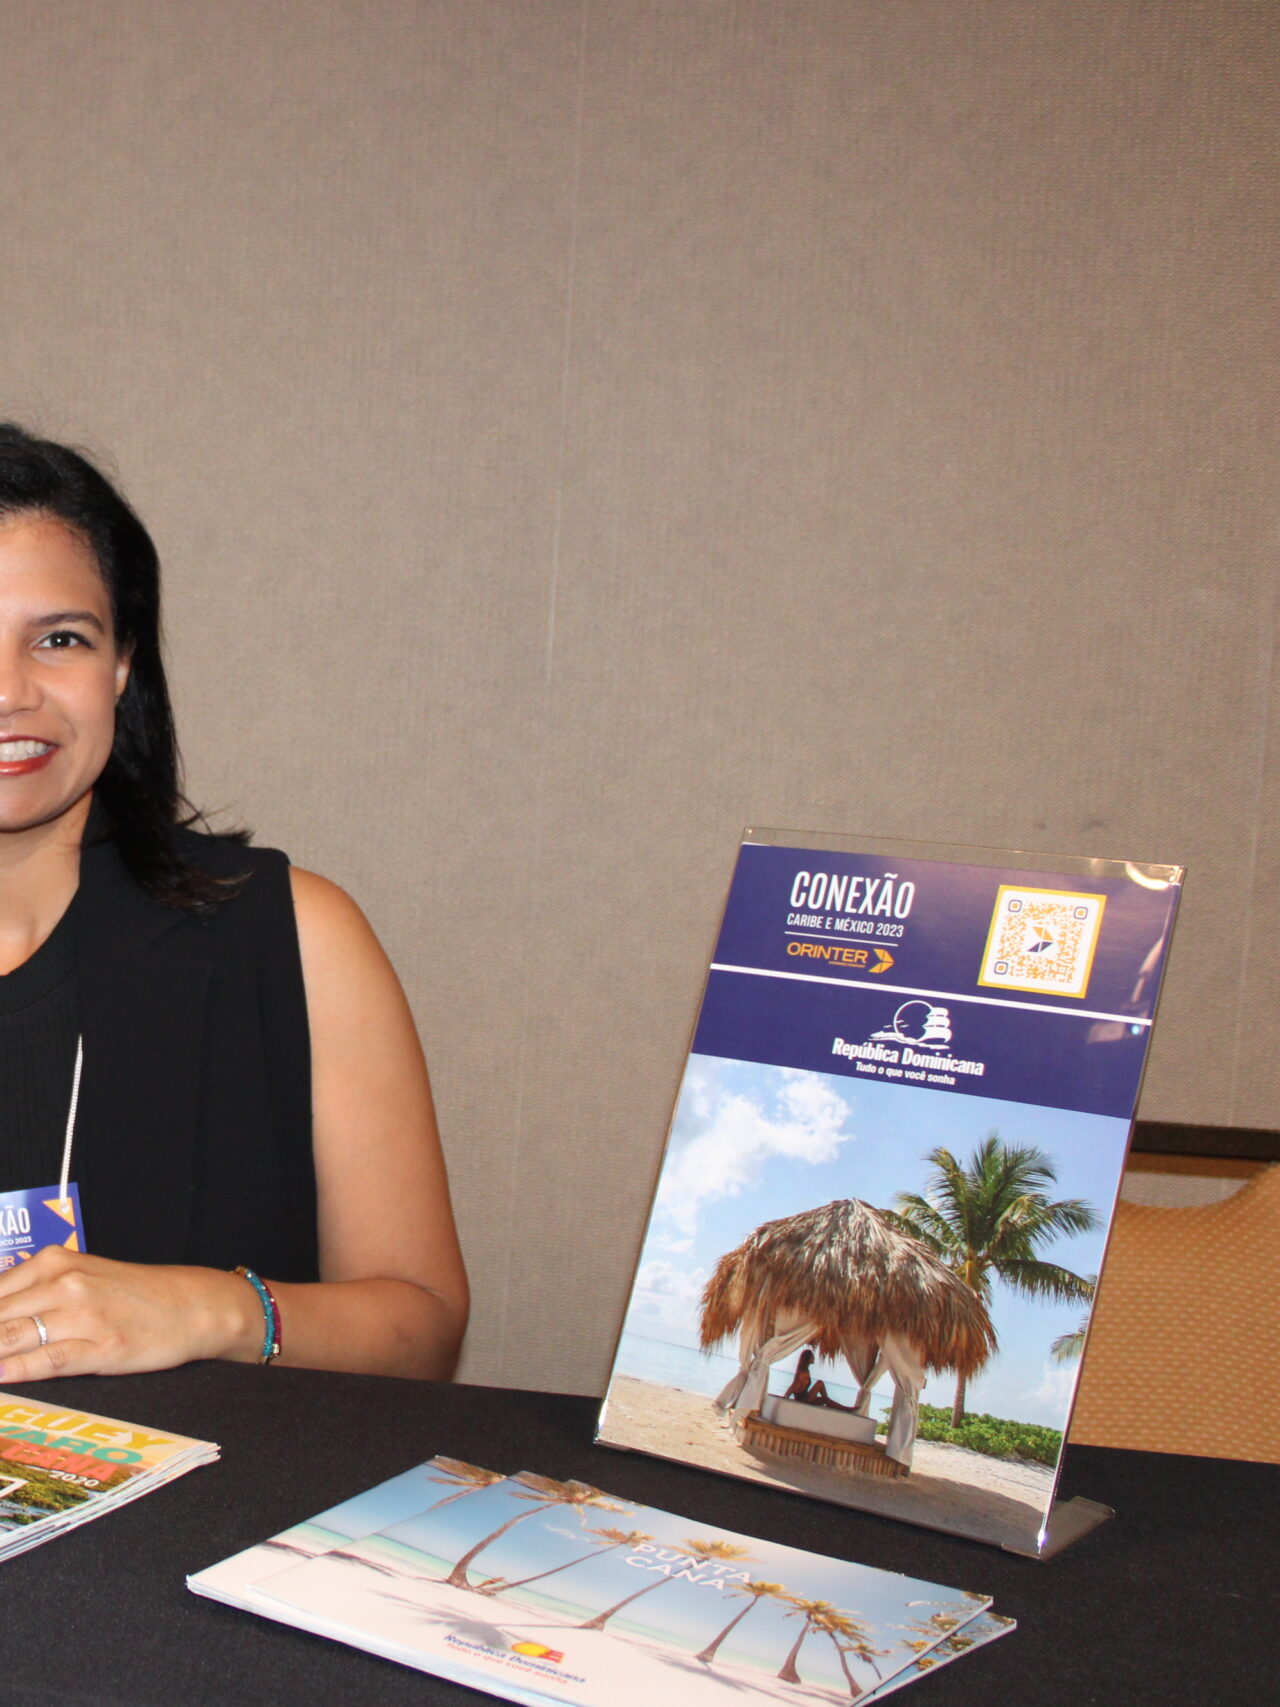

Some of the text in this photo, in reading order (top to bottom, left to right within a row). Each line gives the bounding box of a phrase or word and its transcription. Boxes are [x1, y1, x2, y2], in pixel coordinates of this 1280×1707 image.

[790, 871, 915, 919] CONEXÃO
[786, 912, 904, 938] CARIBE E MÉXICO 2023
[786, 942, 869, 964] ORINTER
[832, 1037, 985, 1076] República Dominicana
[856, 1061, 956, 1086] Tudo o que você sonha
[15, 1236, 32, 1245] 2023
[0, 1443, 119, 1482] CANA
[48, 1469, 100, 1487] 2020
[624, 1556, 725, 1590] CANA
[631, 1543, 751, 1583] PUNTA
